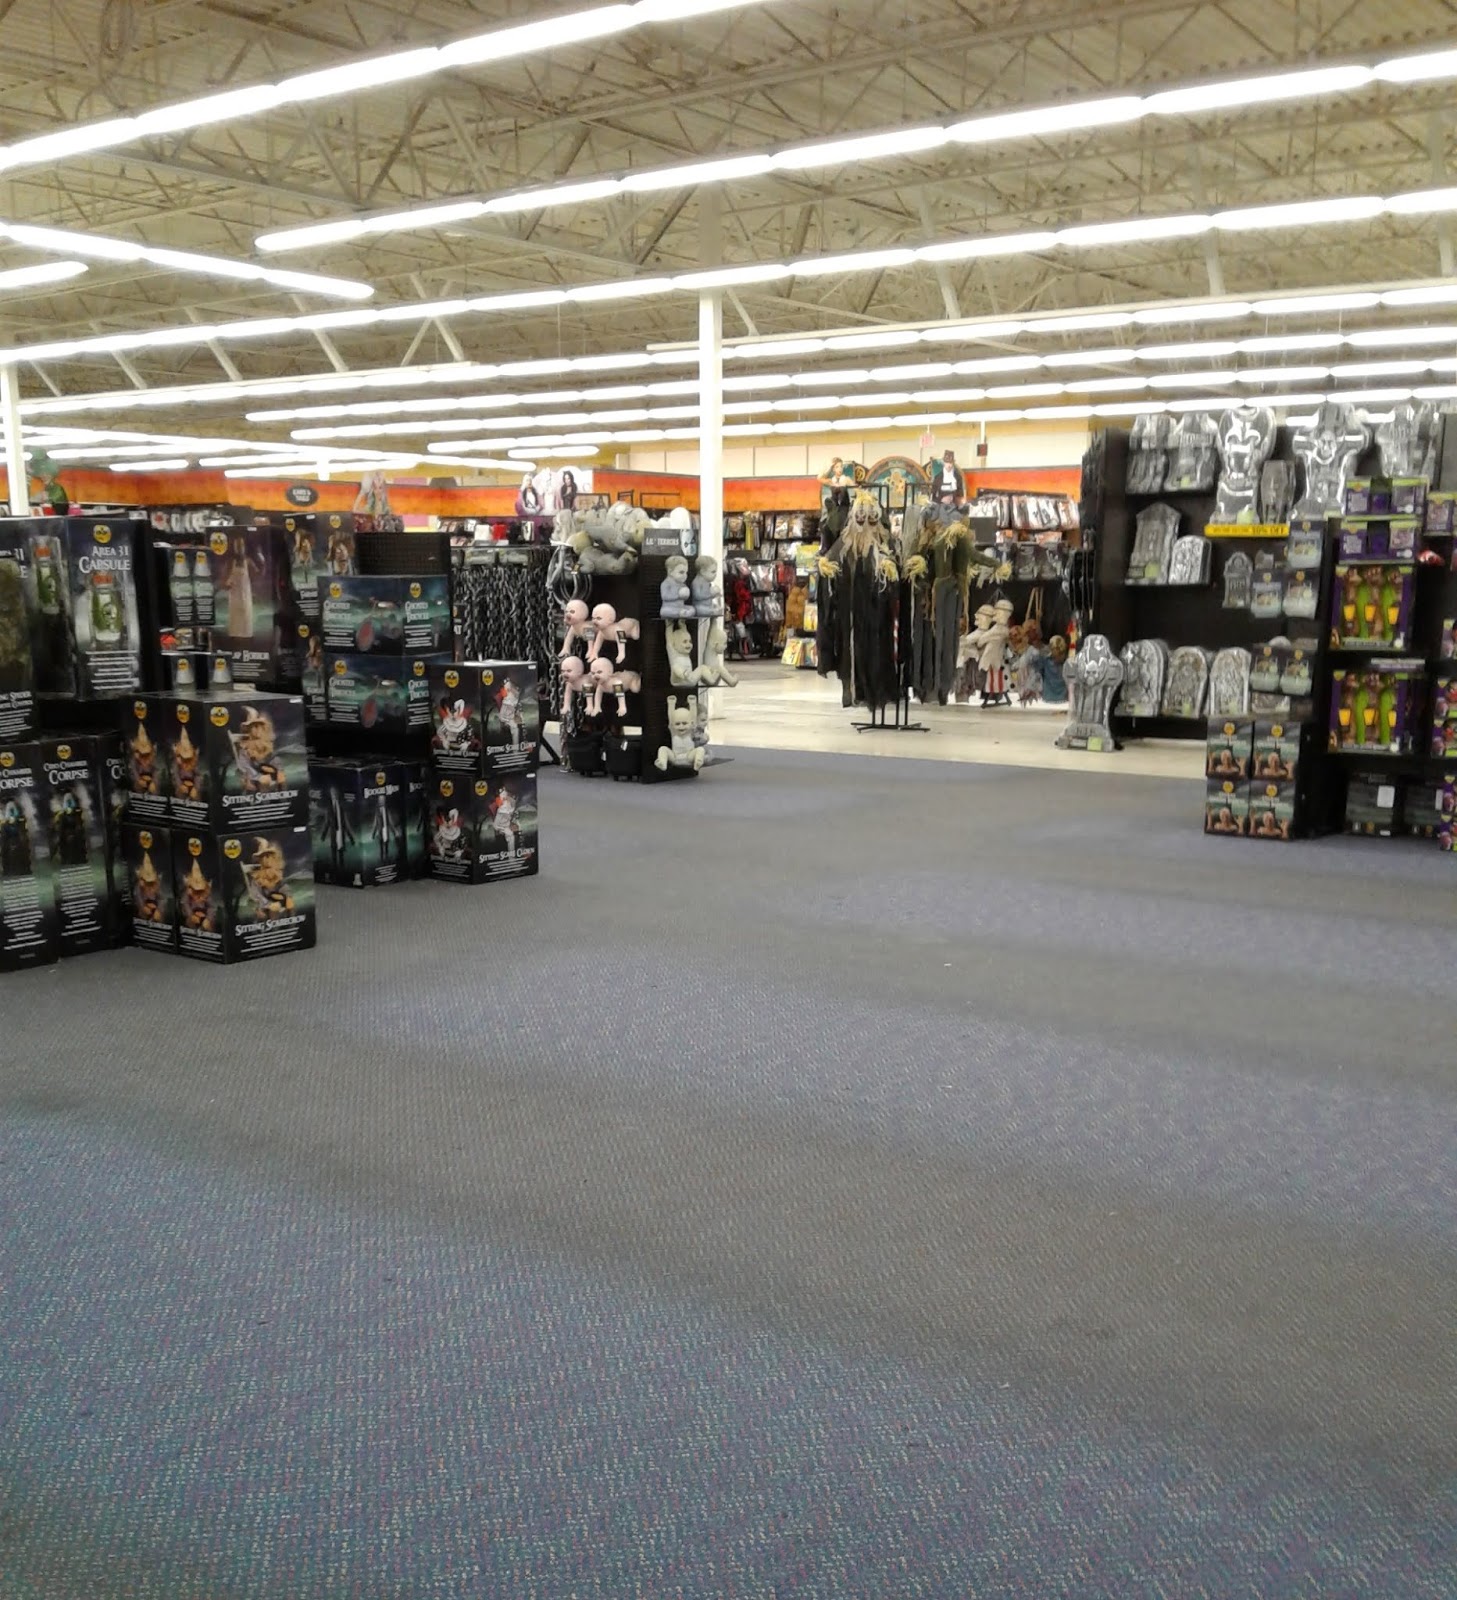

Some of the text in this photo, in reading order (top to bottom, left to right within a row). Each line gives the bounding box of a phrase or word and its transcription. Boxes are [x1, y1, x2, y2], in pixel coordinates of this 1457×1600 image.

[92, 545, 116, 557] AREA
[79, 556, 131, 573] CAPSULE
[486, 745, 505, 756] SITTING
[48, 768, 89, 785] CORPSE
[222, 794, 253, 807] SITTING
[255, 789, 299, 804] SCARECROW
[479, 852, 500, 864] SITTING
[235, 922, 264, 937] SITTING
[265, 914, 307, 931] SCARECROW
